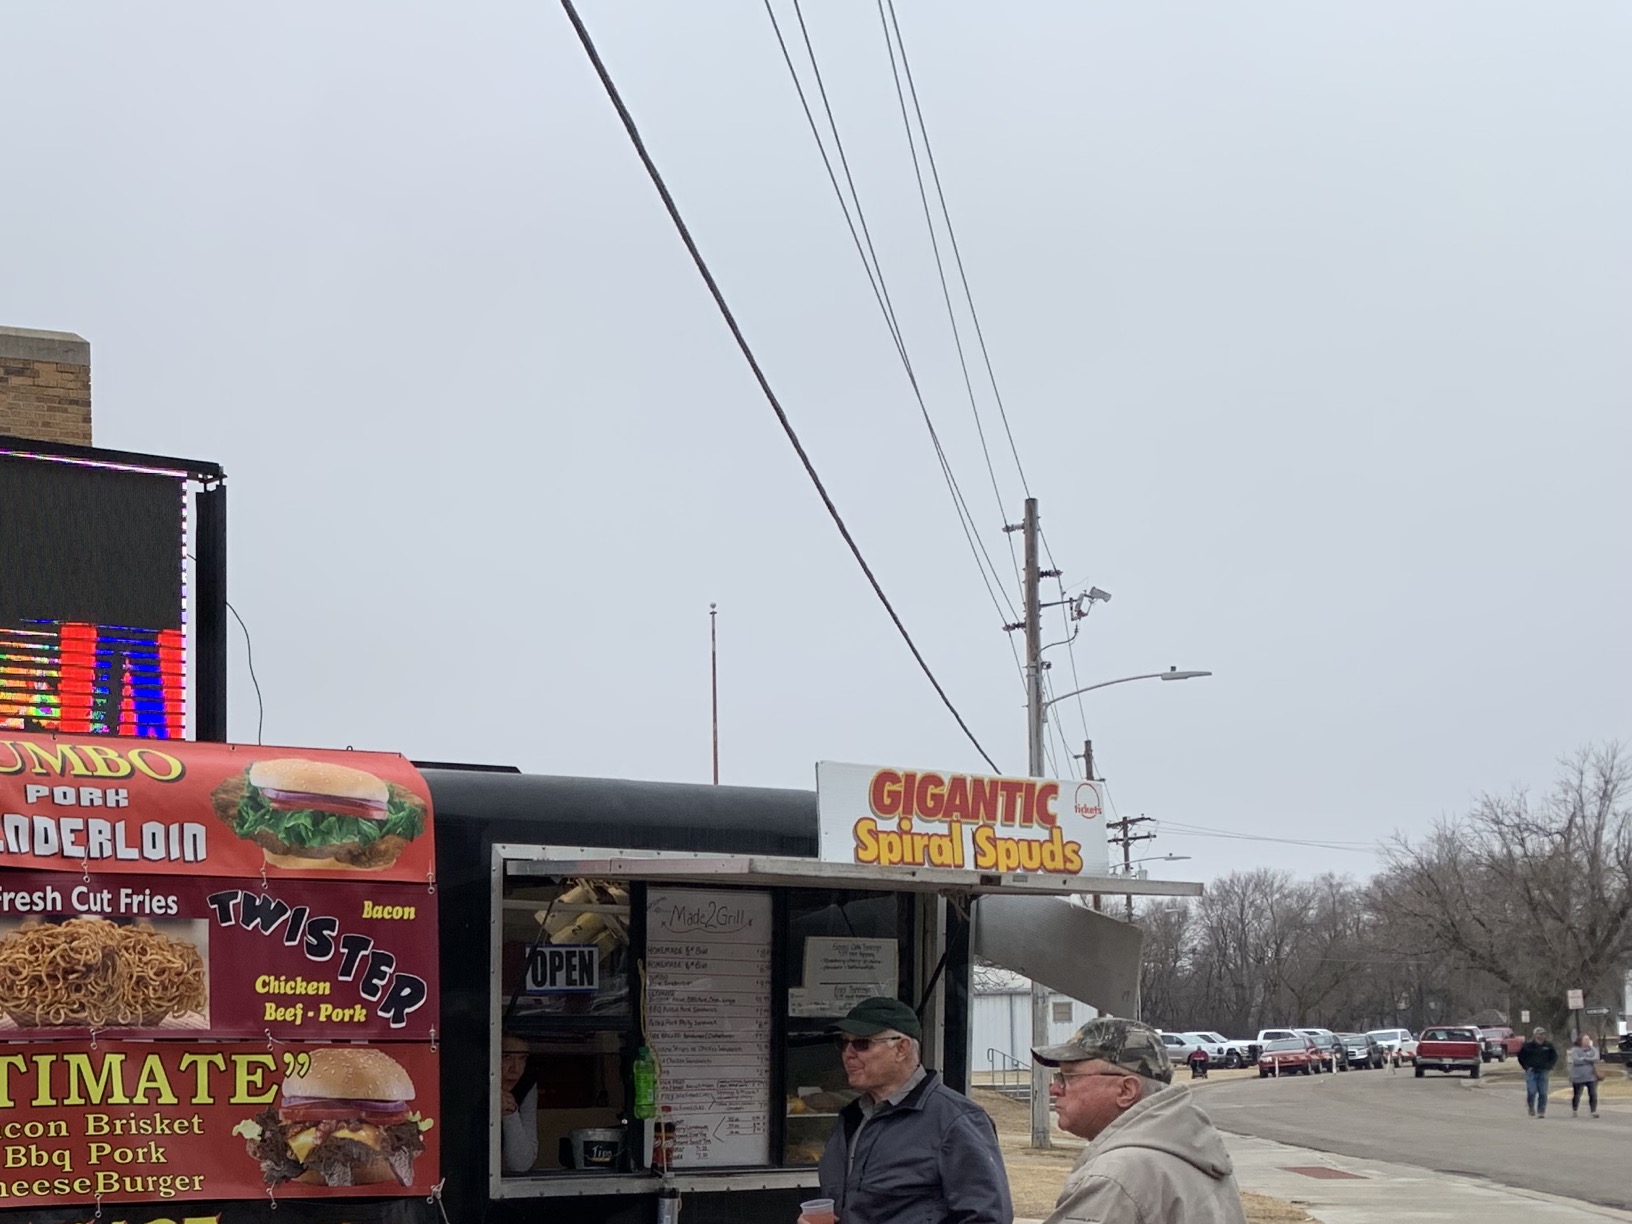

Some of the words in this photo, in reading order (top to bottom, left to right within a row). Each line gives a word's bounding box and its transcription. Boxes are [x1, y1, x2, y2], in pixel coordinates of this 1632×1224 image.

[25, 782, 130, 809] PORK
[870, 768, 1060, 829] GIGANTIC
[854, 815, 965, 867] Spiral
[972, 824, 1083, 875] Spuds
[70, 886, 114, 914] Cut
[120, 888, 178, 916] Fries
[362, 901, 415, 921] Bacon
[207, 888, 429, 1028] TWISTER
[531, 950, 594, 987] OPEN
[255, 974, 331, 997] Chicken
[263, 1002, 303, 1022] Beef
[318, 1003, 368, 1023] Pork
[84, 1112, 205, 1138] Brisket
[5, 1143, 73, 1173] Bbq
[87, 1141, 168, 1166] Pork
